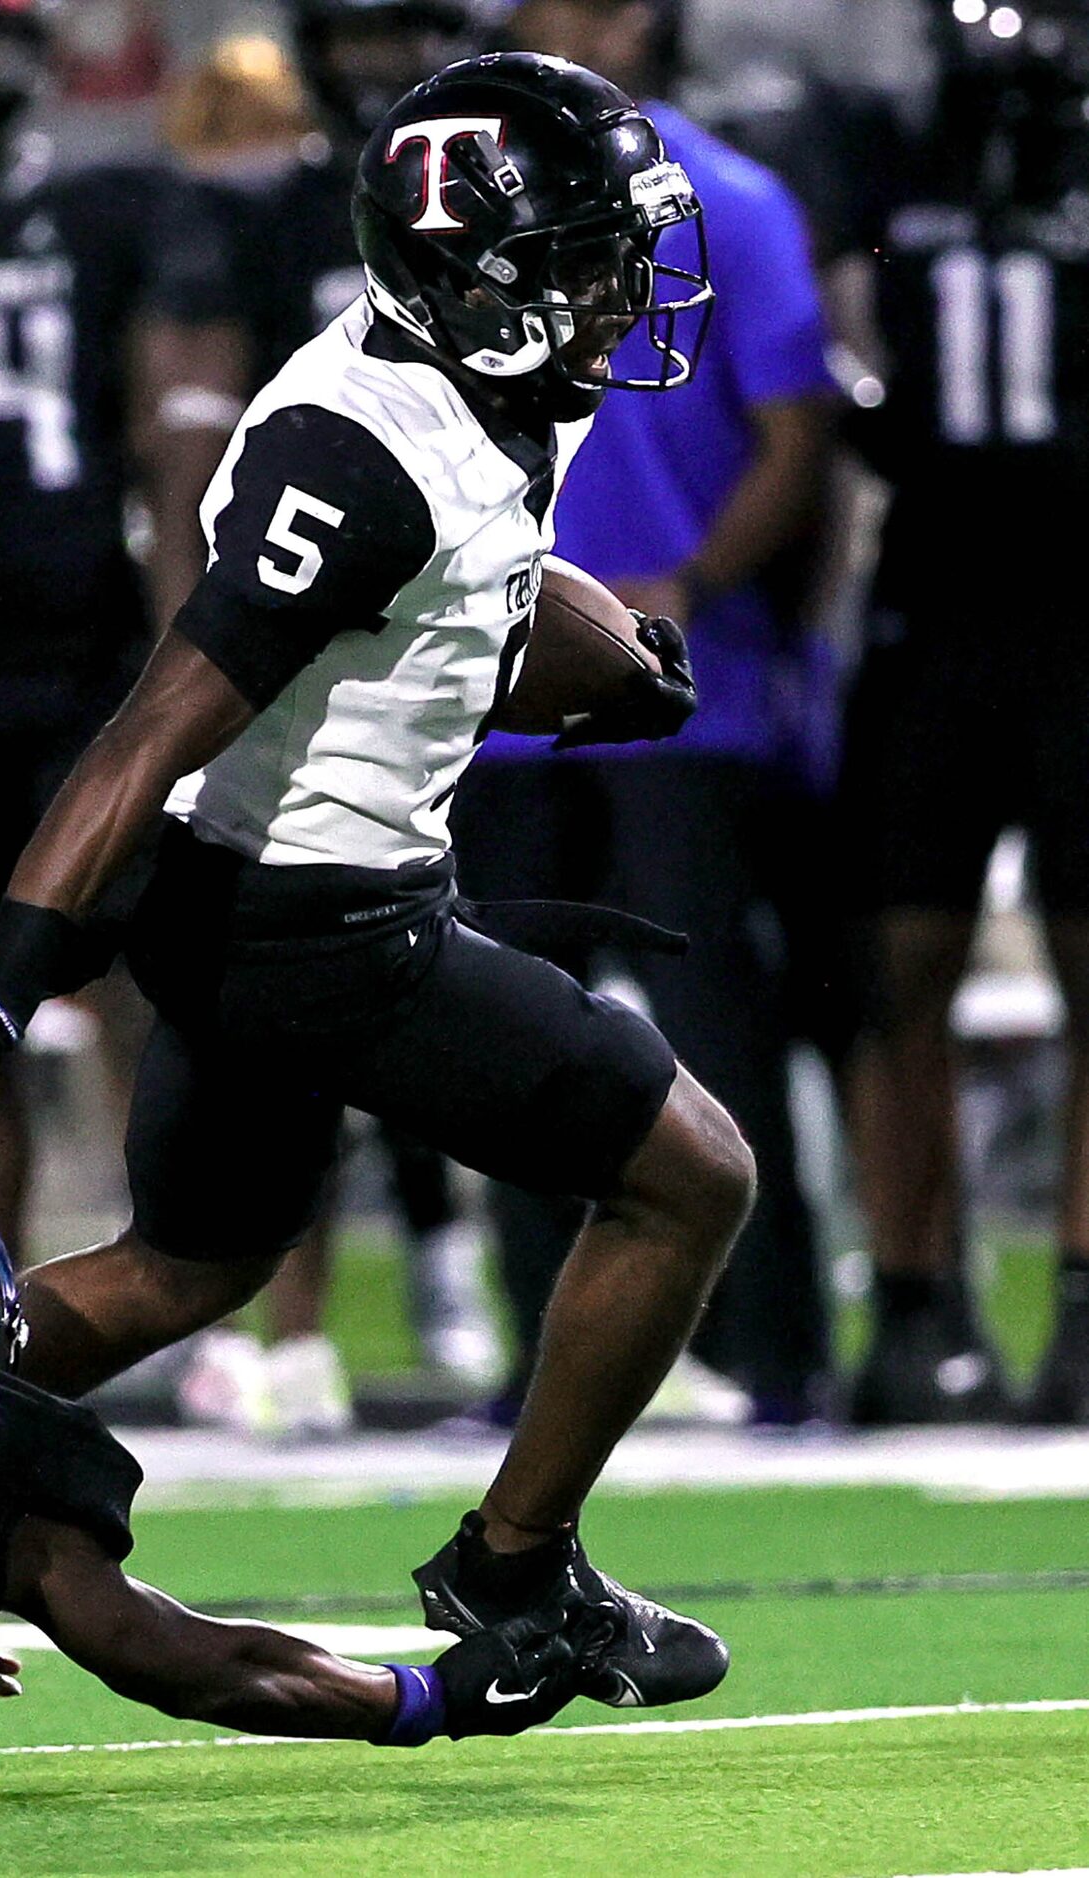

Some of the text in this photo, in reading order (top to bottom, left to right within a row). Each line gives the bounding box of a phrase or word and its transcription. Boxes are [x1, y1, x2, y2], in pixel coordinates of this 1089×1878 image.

[385, 113, 509, 235] T
[929, 252, 1057, 443] 11
[257, 484, 346, 595] 5
